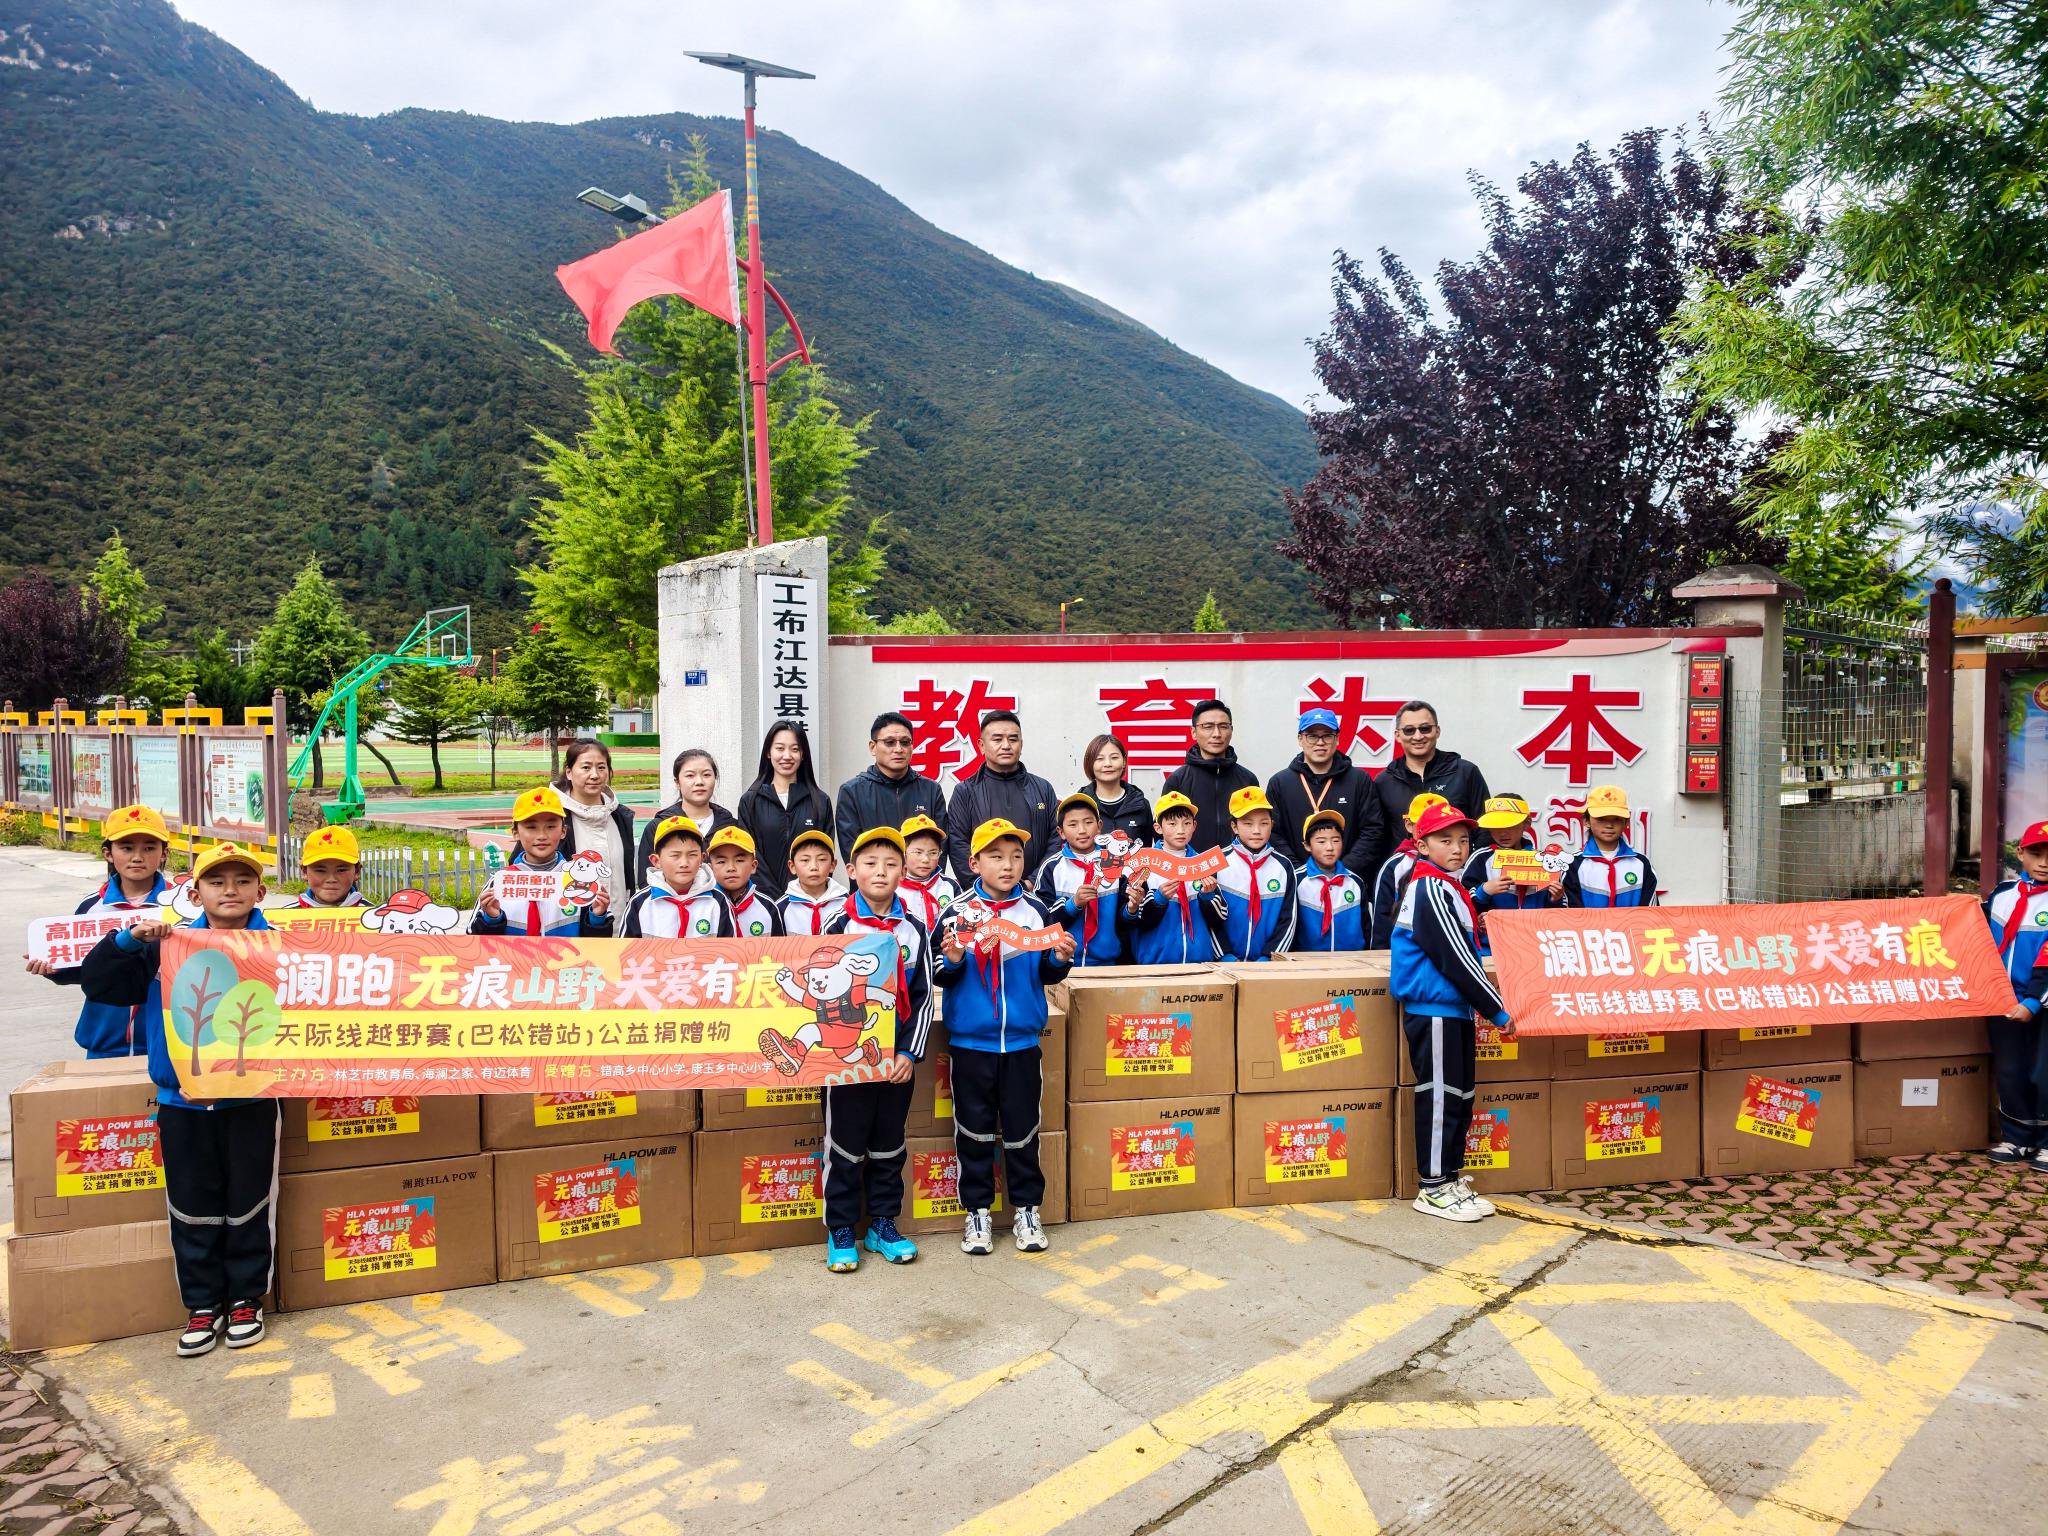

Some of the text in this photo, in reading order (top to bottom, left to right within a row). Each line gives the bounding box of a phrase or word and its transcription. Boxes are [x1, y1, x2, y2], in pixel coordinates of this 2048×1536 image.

[773, 583, 809, 732] 工布江达县
[899, 677, 1643, 785] 教育为本
[1178, 855, 1220, 876] 留下温暖
[1497, 854, 1533, 864] 与爱同行
[502, 874, 556, 886] 高原童心
[502, 887, 556, 899] 共同守护
[1536, 919, 1956, 977] 澜跑 无痕山野 关爱有痕
[274, 951, 788, 1012] 澜跑 无痕山野 关爱有痕
[1183, 994, 1207, 1002] POW
[1327, 989, 1345, 997] HLA
[1122, 1026, 1174, 1041] 无痕山野
[1124, 1041, 1173, 1058] 关爱有痕
[1941, 1067, 1958, 1076] HLA
[1805, 1076, 1827, 1084] POW
[1652, 1085, 1674, 1093] POW
[1913, 1085, 1928, 1095] 林芝
[1502, 1093, 1524, 1101] POW
[331, 1098, 396, 1118] 关爱有痕
[1160, 1110, 1180, 1119] HLA
[1181, 1108, 1204, 1117] POW
[1323, 1104, 1342, 1112] HLA
[1343, 1103, 1367, 1111] POW
[1599, 1111, 1645, 1125] 无痕山野
[83, 1124, 103, 1132] HLA
[108, 1122, 131, 1130] POW
[331, 1123, 397, 1136] 公益捐赠物资
[1601, 1124, 1645, 1142] 关爱有痕
[79, 1132, 157, 1151] 无痕山野
[795, 1138, 815, 1147] HLA
[1127, 1138, 1178, 1153] 无痕山野
[1279, 1132, 1329, 1147] 无痕山野
[82, 1148, 156, 1172] 关爱有痕
[604, 1152, 626, 1162] HLA
[629, 1148, 657, 1159] POW
[1129, 1152, 1178, 1170] 关爱有痕
[1282, 1145, 1330, 1164] 关爱有痕
[762, 1159, 777, 1168] HLA
[780, 1158, 798, 1166] POW
[452, 1171, 477, 1182] POW
[576, 1171, 595, 1180] POW
[759, 1168, 816, 1184] 无痕山野
[928, 1164, 957, 1179] 无痕
[83, 1176, 157, 1190] 公益捐赠物资
[554, 1178, 617, 1200] 无痕山野
[931, 1180, 957, 1197] 关爱
[761, 1183, 815, 1202] 关爱有痕
[347, 1210, 365, 1218] HLA
[369, 1207, 389, 1216] POW
[558, 1193, 618, 1220] 关爱有痕
[344, 1217, 412, 1236] 无痕山野
[347, 1232, 412, 1256] 关爱有痕
[349, 1259, 413, 1273] 公益捐赠物资
